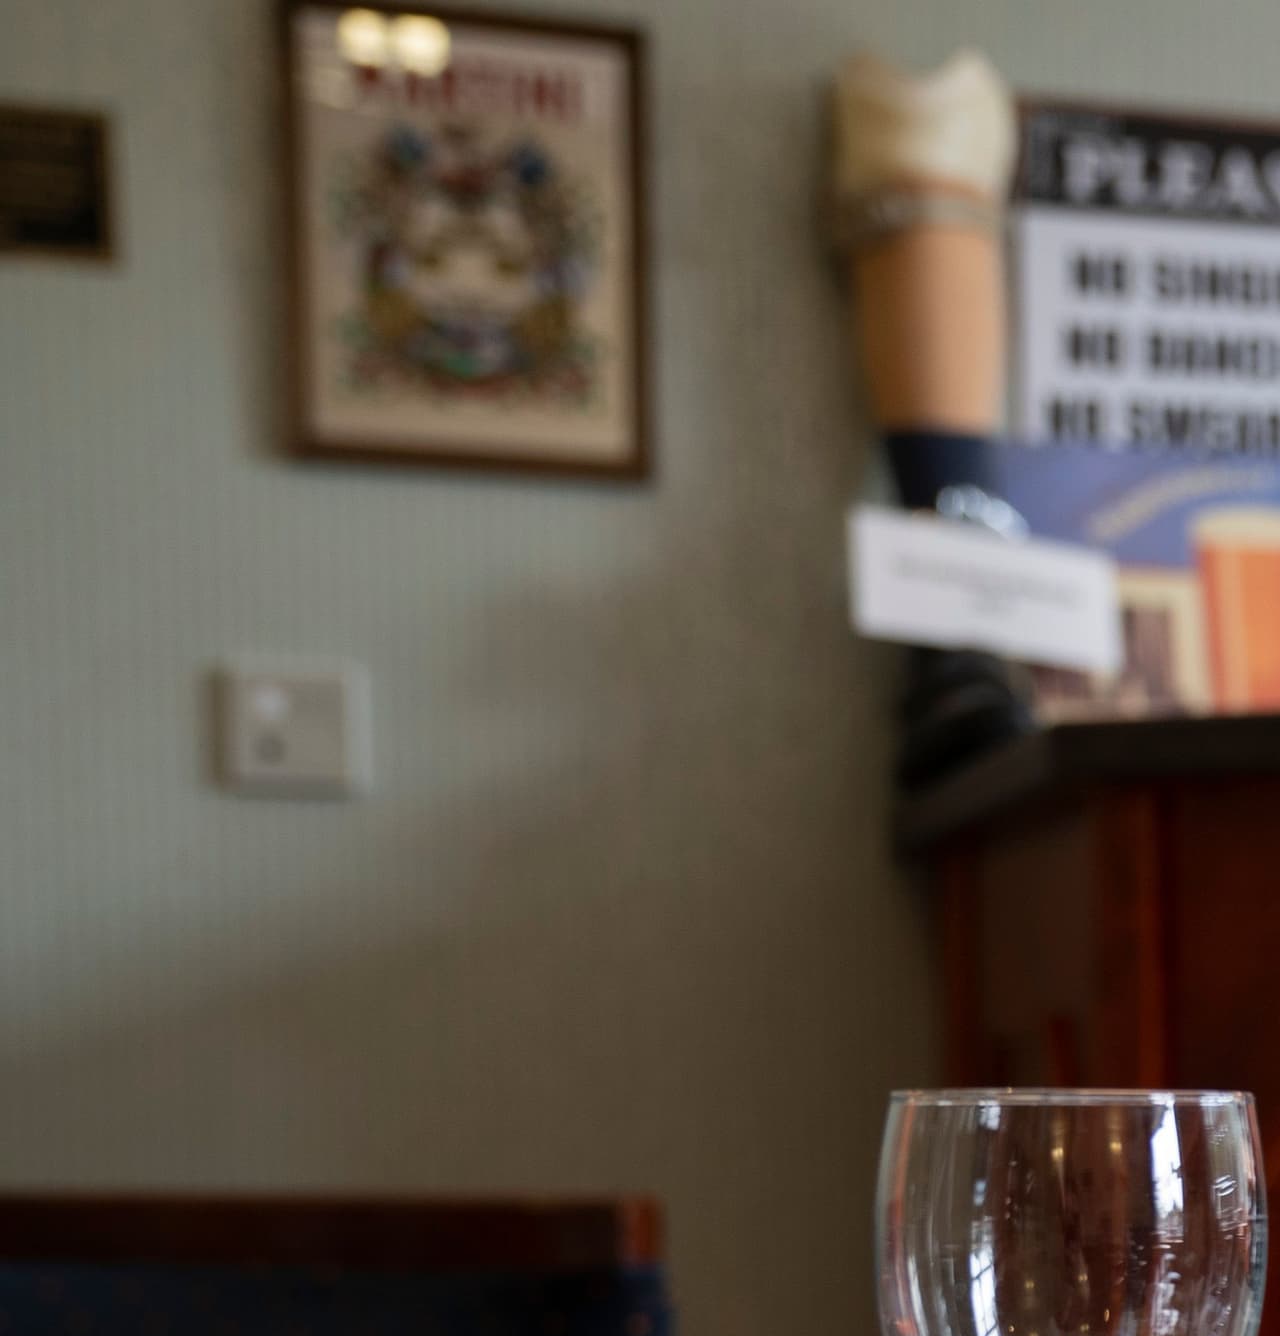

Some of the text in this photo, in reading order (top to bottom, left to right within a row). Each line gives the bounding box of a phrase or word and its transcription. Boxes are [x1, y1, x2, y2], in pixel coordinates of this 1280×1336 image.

[1070, 250, 1131, 300] NO
[1064, 321, 1125, 372] NO
[1044, 394, 1104, 440] NO
